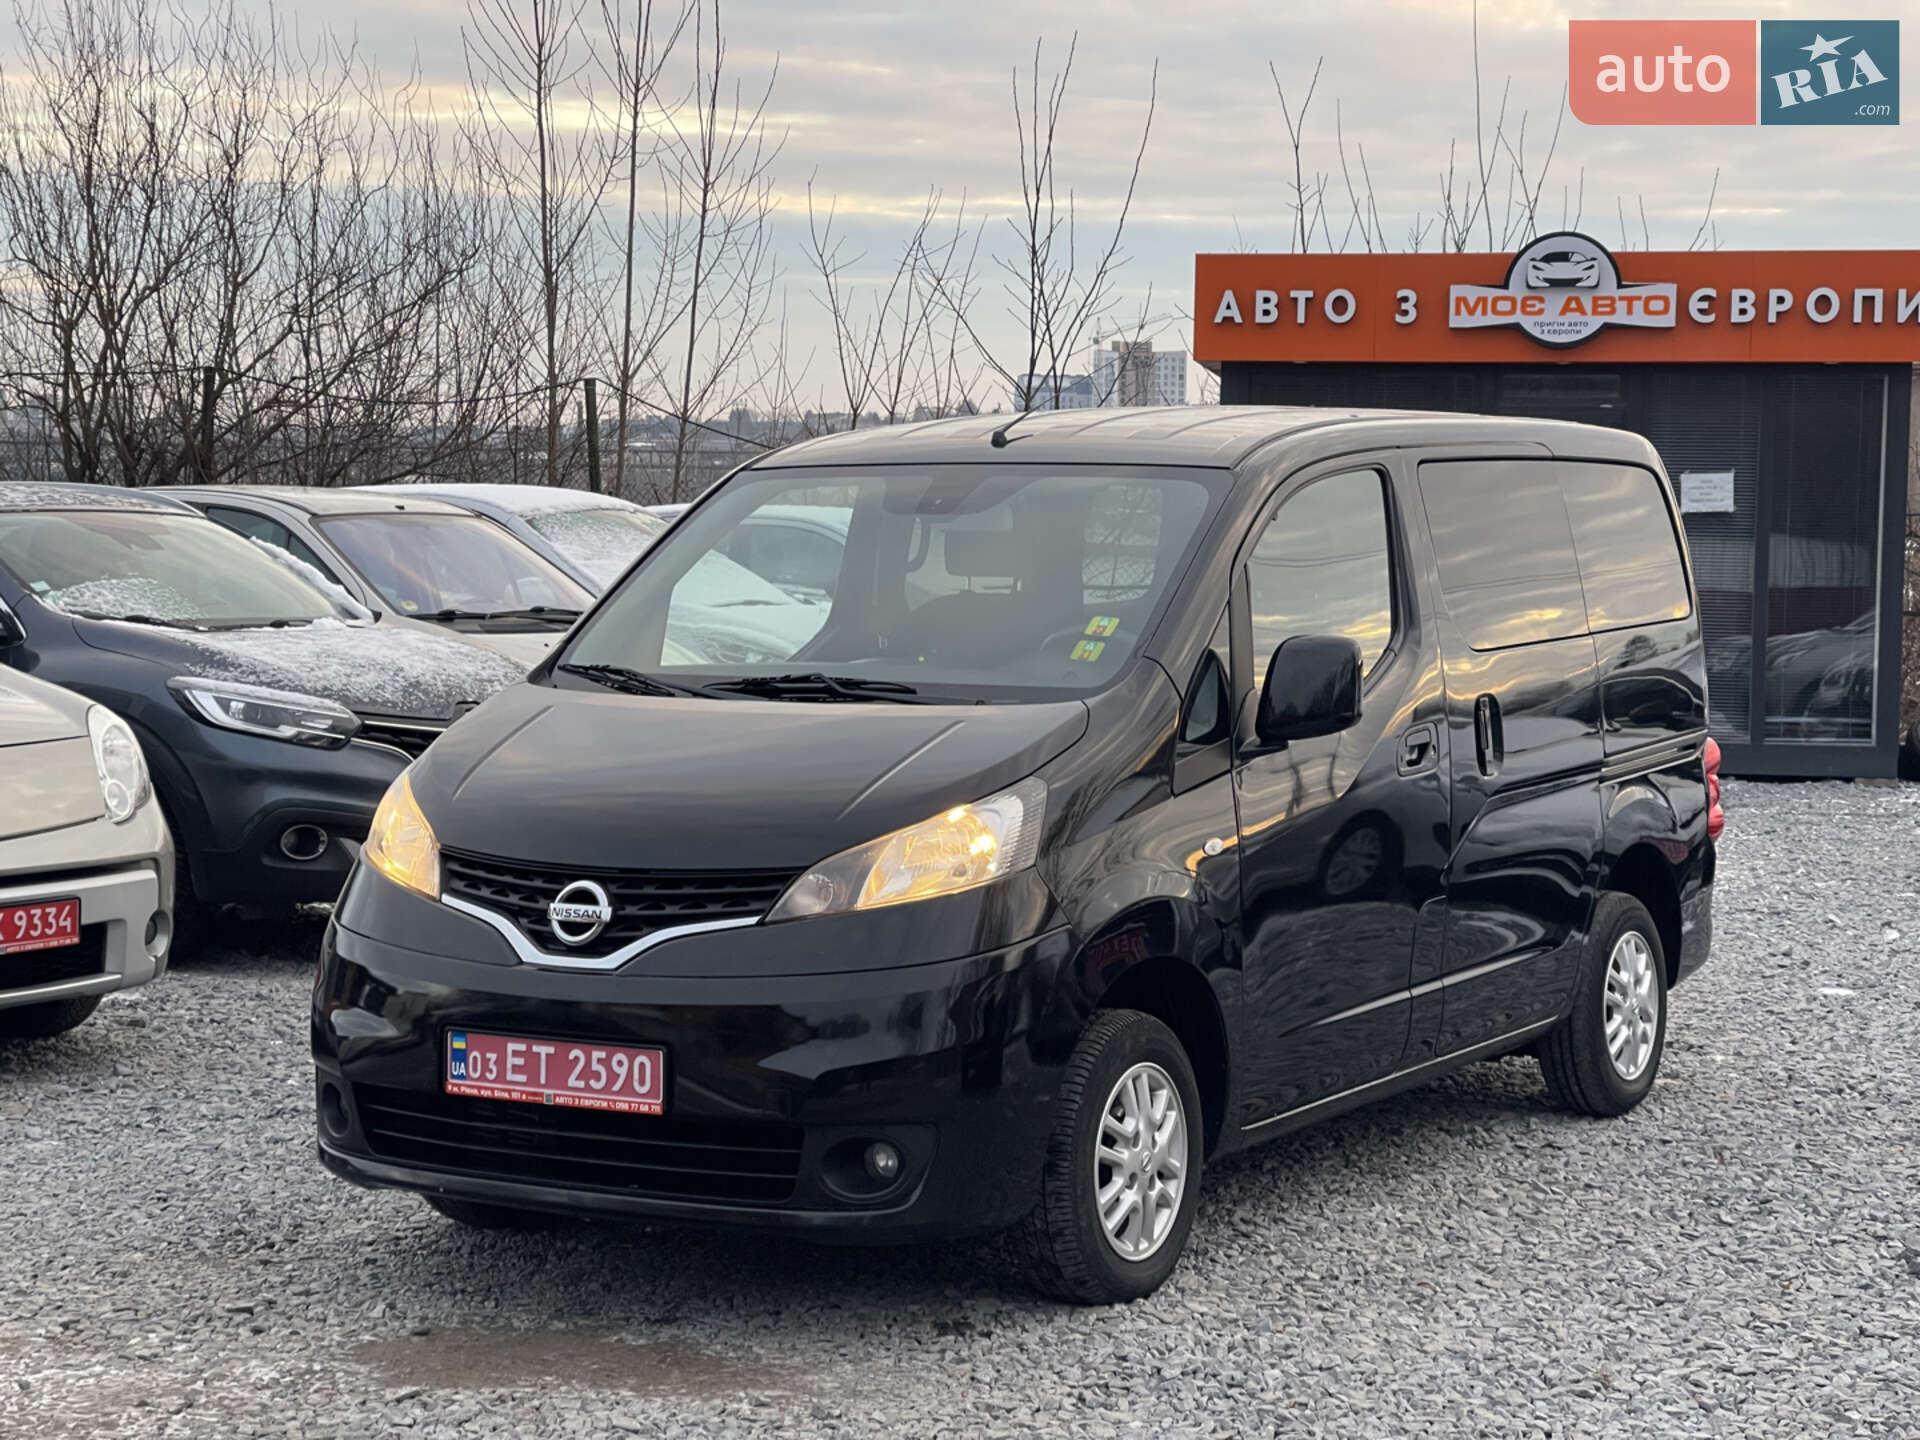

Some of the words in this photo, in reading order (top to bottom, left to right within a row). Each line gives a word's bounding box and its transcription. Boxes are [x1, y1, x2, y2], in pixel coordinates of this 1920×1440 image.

[1213, 288, 1356, 324] АВТО
[1394, 288, 1418, 324] З
[1688, 287, 1920, 324] ЄВРОПИ
[1454, 295, 1545, 317] МОЄ
[1558, 295, 1671, 317] АВТО
[1567, 320, 1589, 328] авто
[14, 905, 71, 939] 9334
[551, 906, 603, 920] NISSAN
[451, 1061, 466, 1076] UA
[468, 1051, 498, 1080] 03
[506, 1042, 555, 1085] ET
[567, 1049, 651, 1095] 2590
